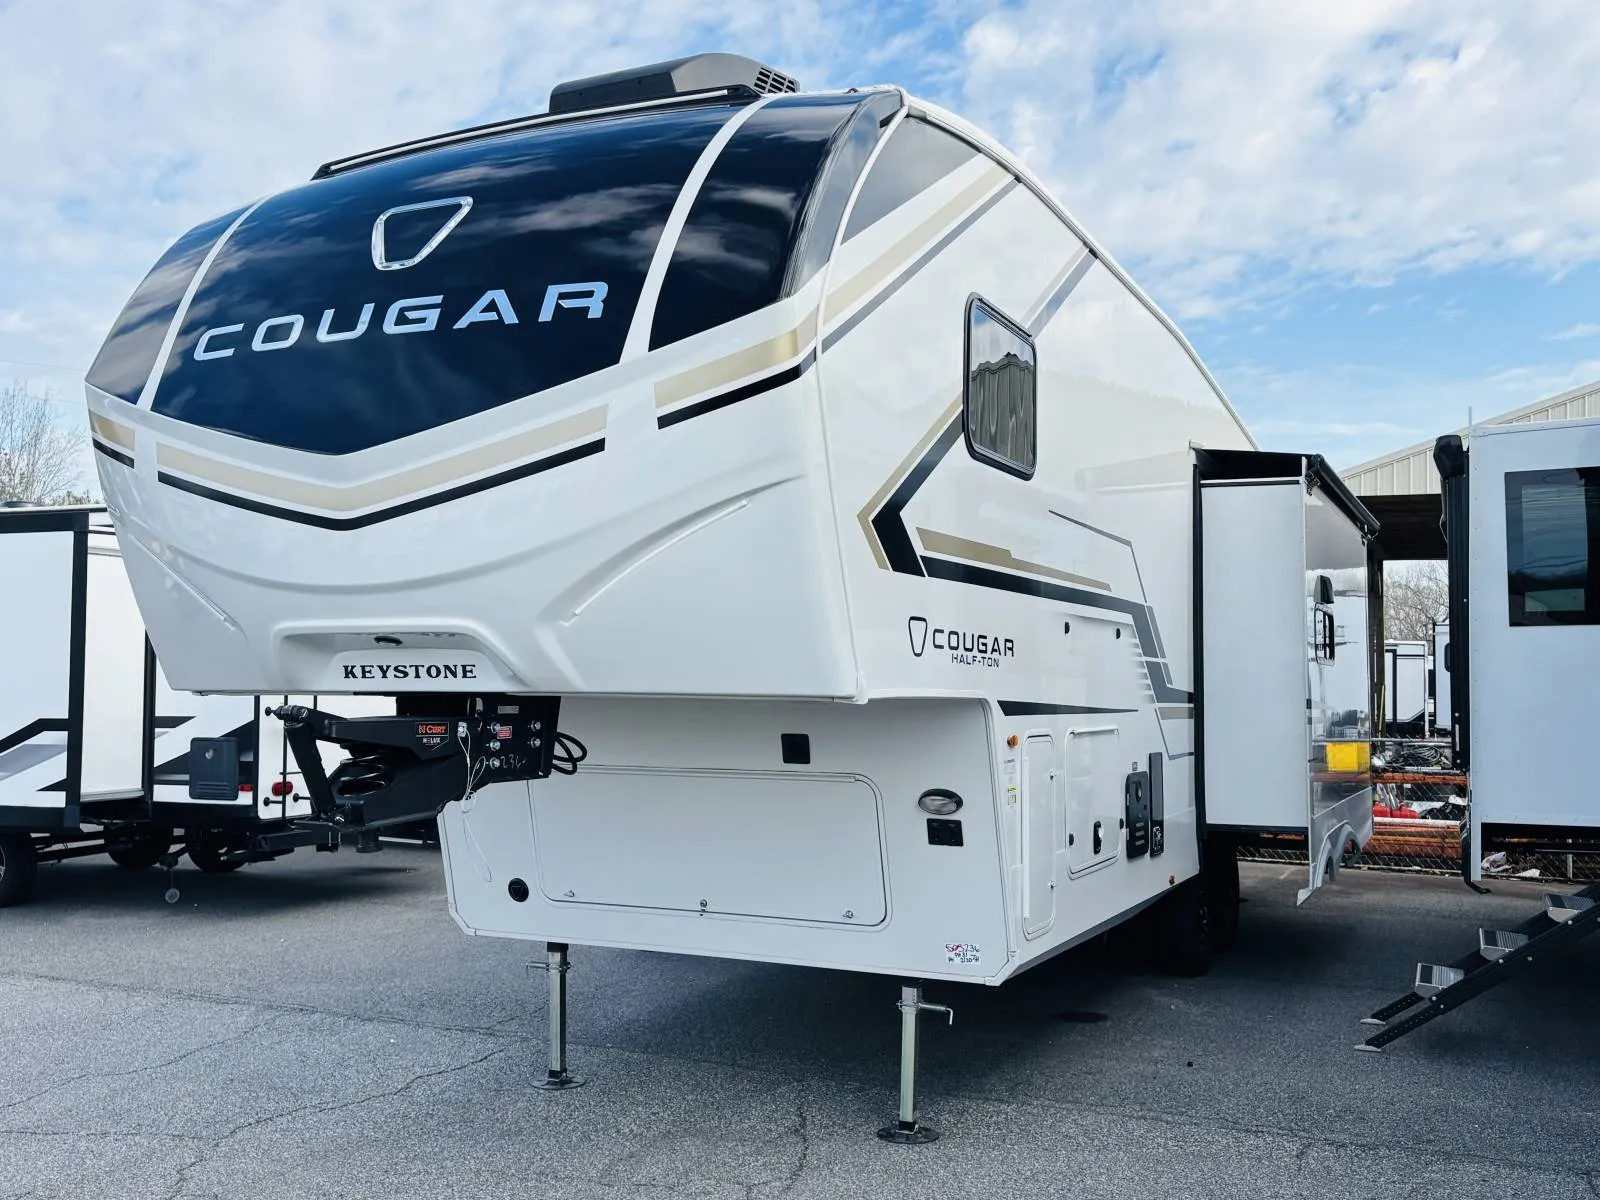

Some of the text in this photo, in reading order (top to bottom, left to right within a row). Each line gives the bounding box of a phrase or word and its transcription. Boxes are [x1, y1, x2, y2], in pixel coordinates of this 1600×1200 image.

[193, 281, 609, 361] COUGAR
[932, 628, 1015, 657] COUGAR
[342, 664, 477, 679] KEYSTONE
[951, 653, 1000, 668] HALF-TON
